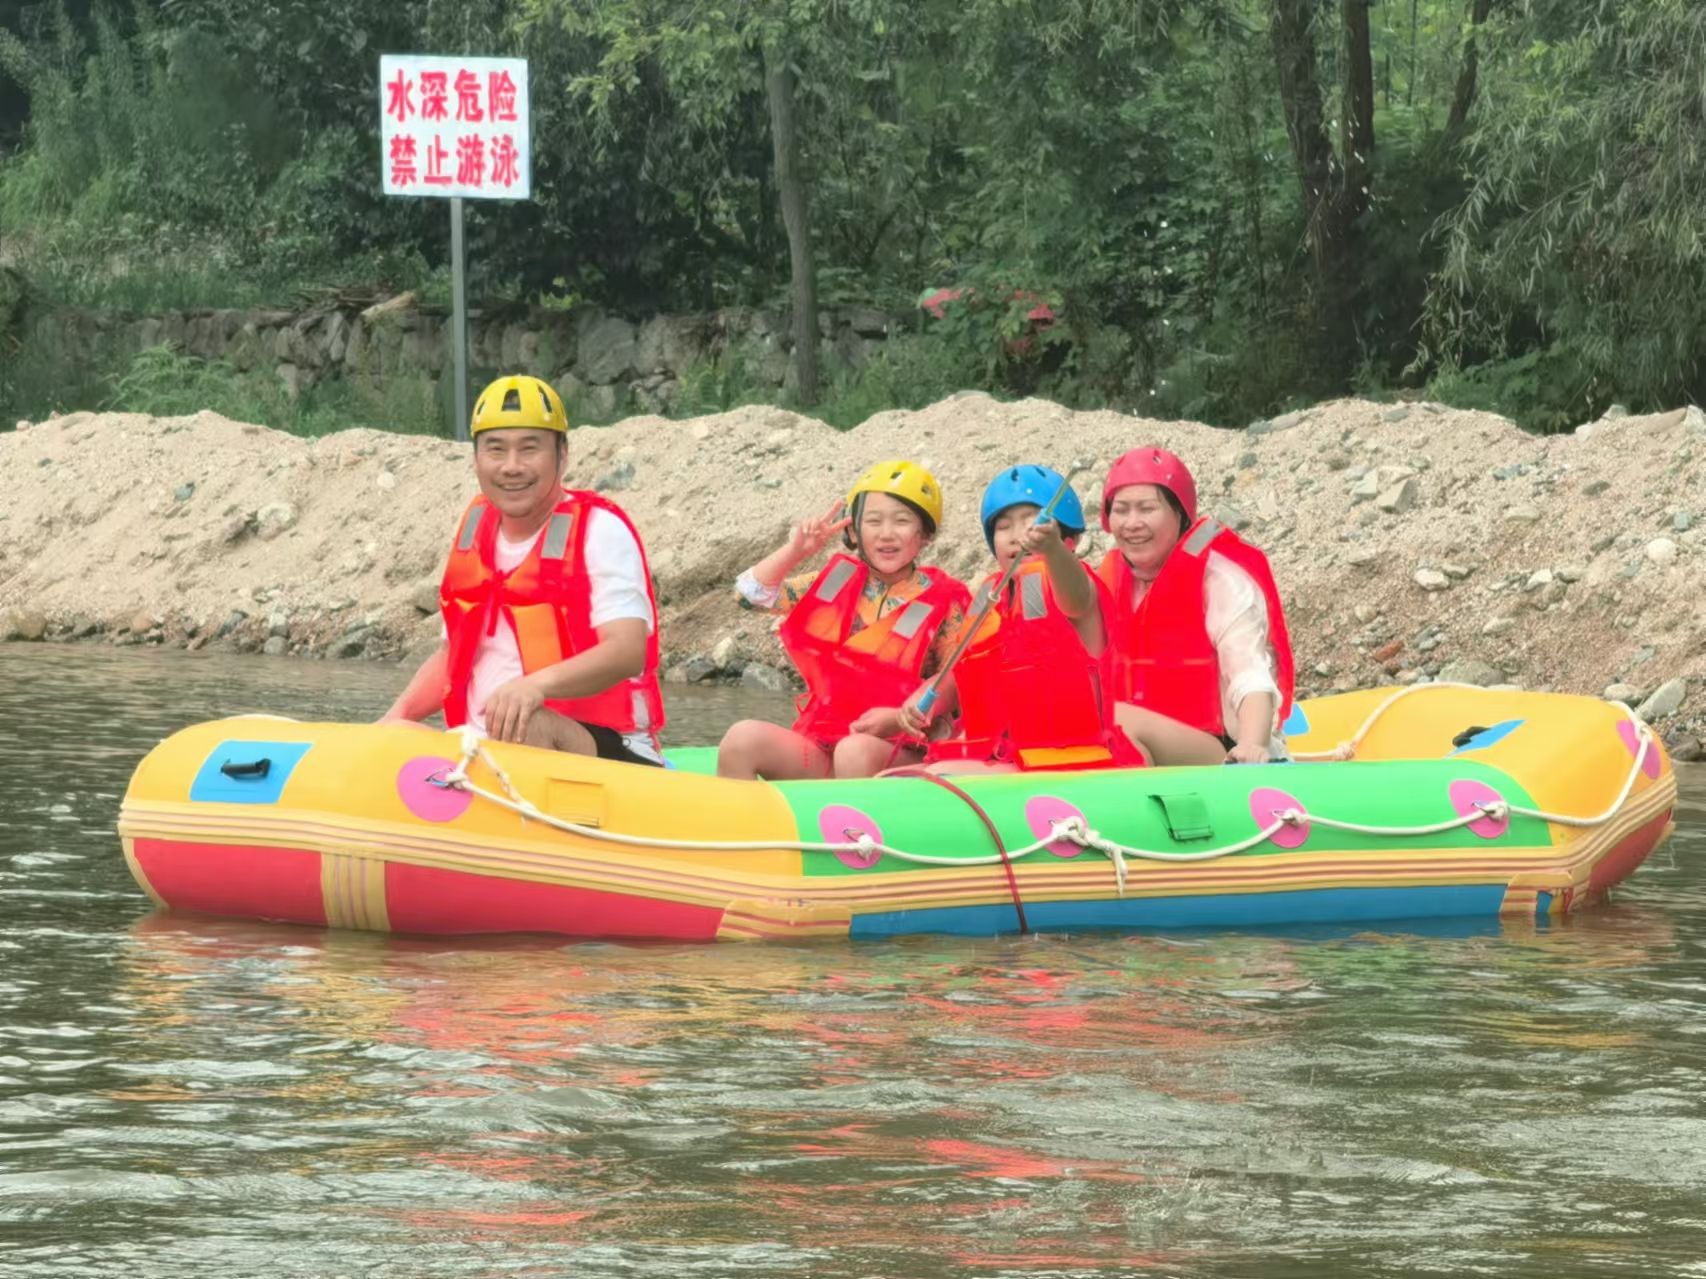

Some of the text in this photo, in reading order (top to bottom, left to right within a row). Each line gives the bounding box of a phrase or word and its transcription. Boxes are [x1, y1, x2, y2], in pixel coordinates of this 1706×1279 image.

[387, 68, 518, 123] 水深危险
[389, 133, 519, 187] 禁止游泳
